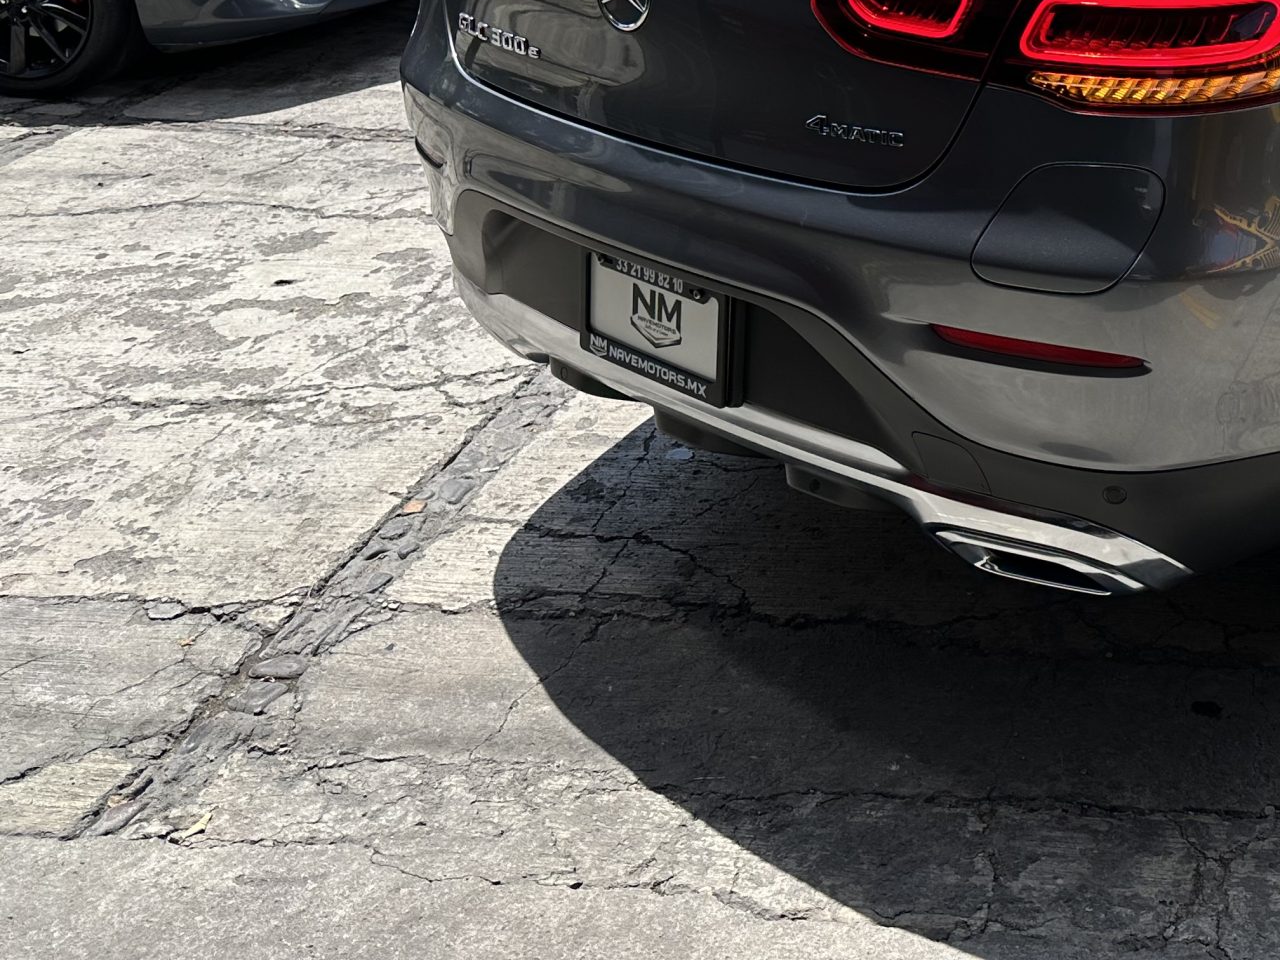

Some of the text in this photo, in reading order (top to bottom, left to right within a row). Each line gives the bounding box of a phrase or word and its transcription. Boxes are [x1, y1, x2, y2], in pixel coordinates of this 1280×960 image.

[458, 12, 489, 41] GLC
[616, 258, 684, 294] 33 21 99 82 10
[632, 282, 682, 336] NM
[590, 333, 708, 399] NM NAVEMOTORS.MX
